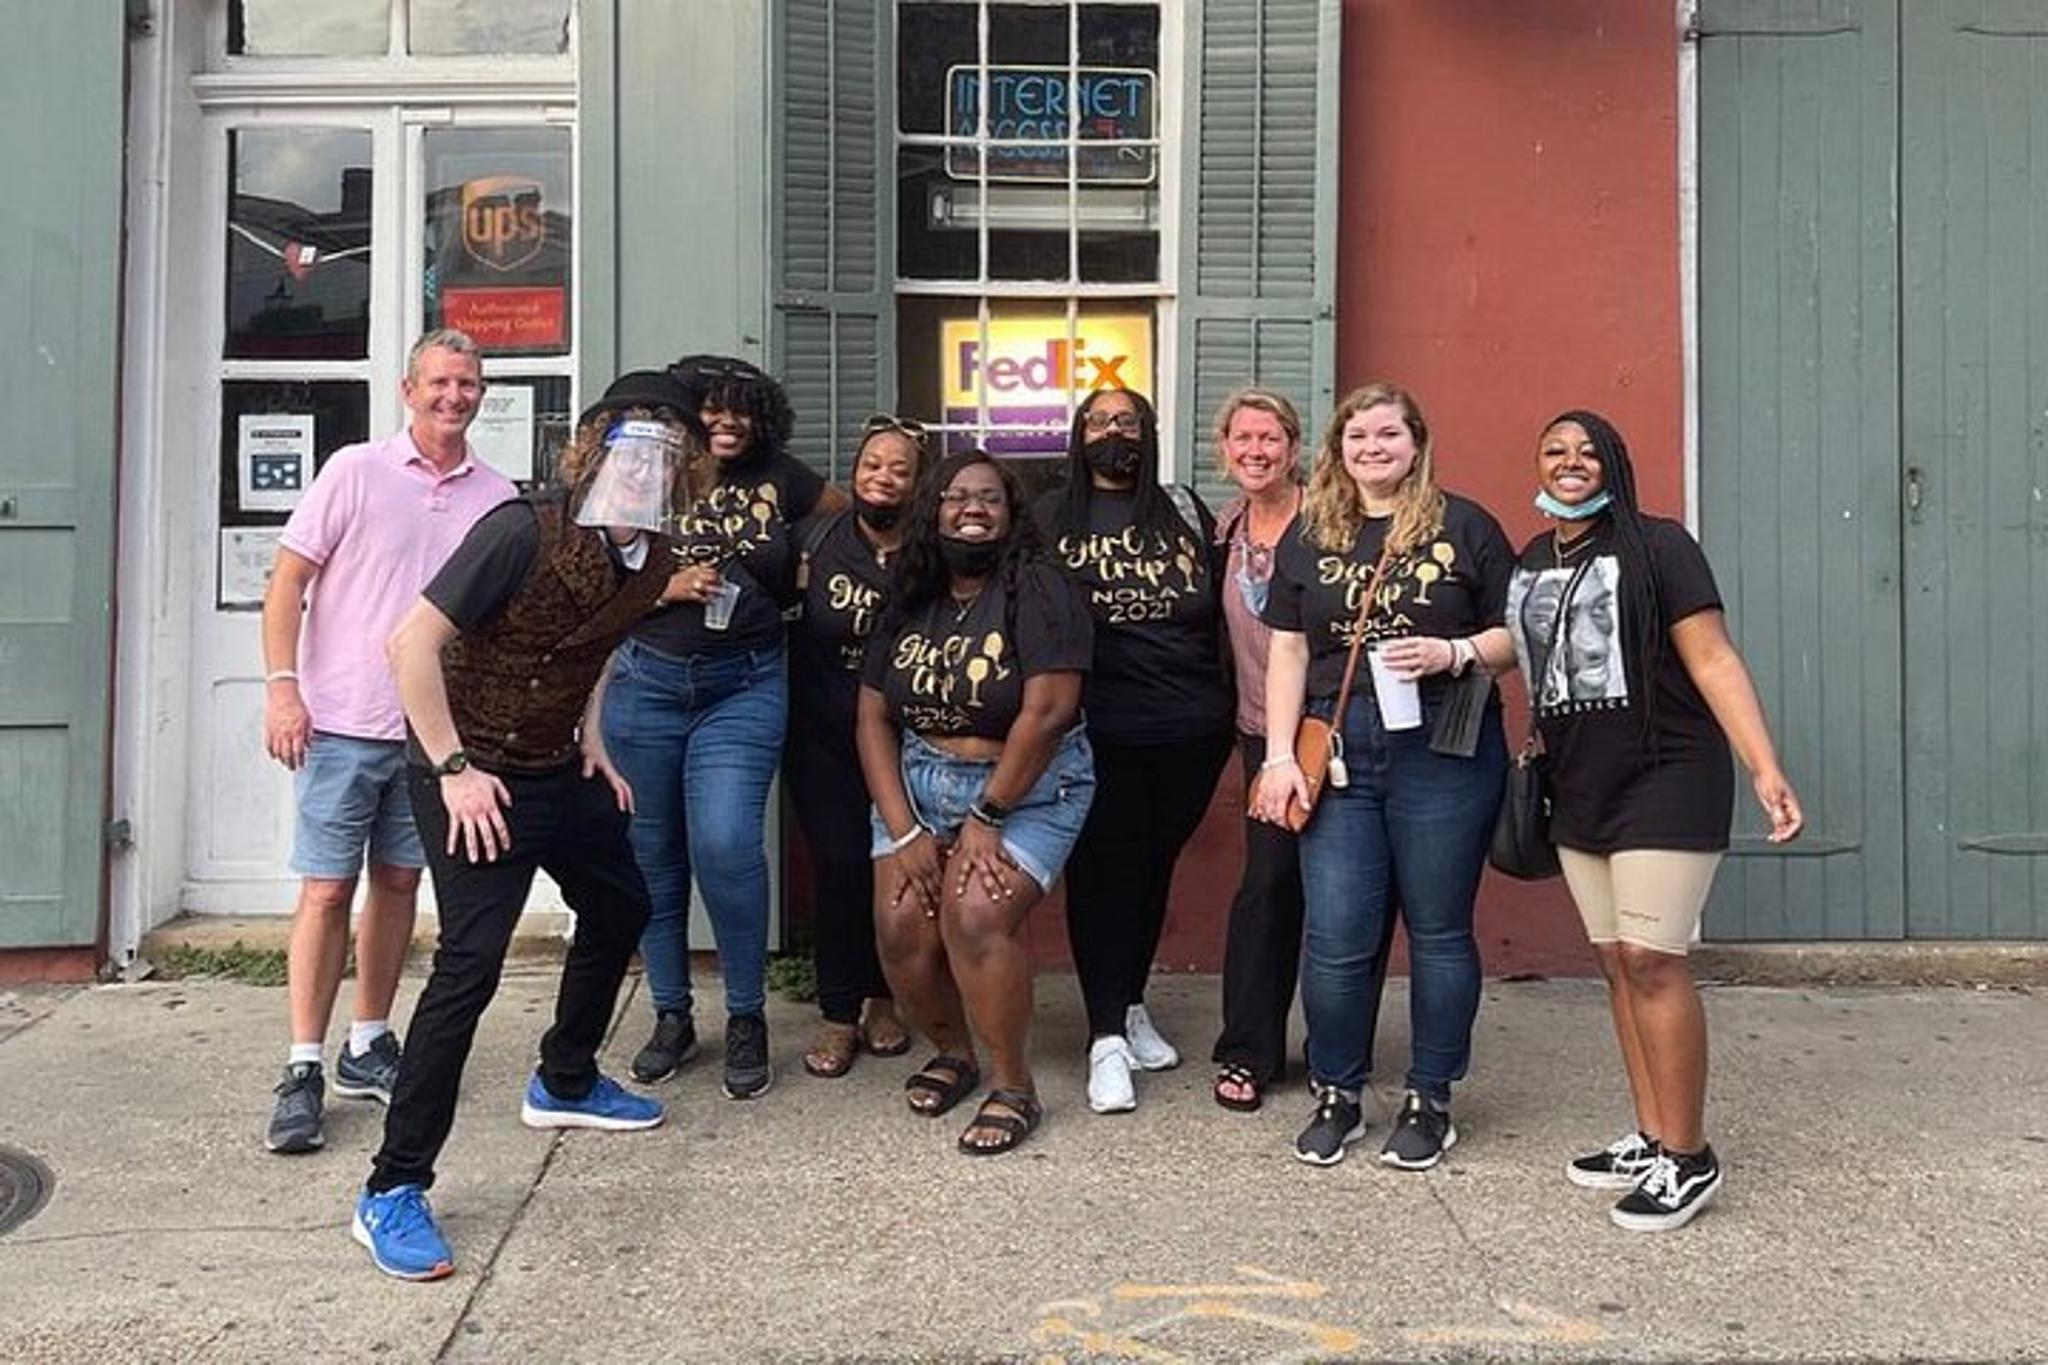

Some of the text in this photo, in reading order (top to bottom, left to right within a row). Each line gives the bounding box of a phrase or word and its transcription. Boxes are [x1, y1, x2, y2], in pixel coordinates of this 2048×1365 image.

[956, 75, 1144, 117] INTERNET
[956, 119, 1067, 158] ACESS
[468, 205, 540, 257] ups
[958, 338, 1128, 393] FedEx
[1057, 525, 1168, 569] girls
[1091, 585, 1180, 604] NOLA
[1108, 600, 1172, 624] 2021
[1329, 613, 1415, 633] NOLA
